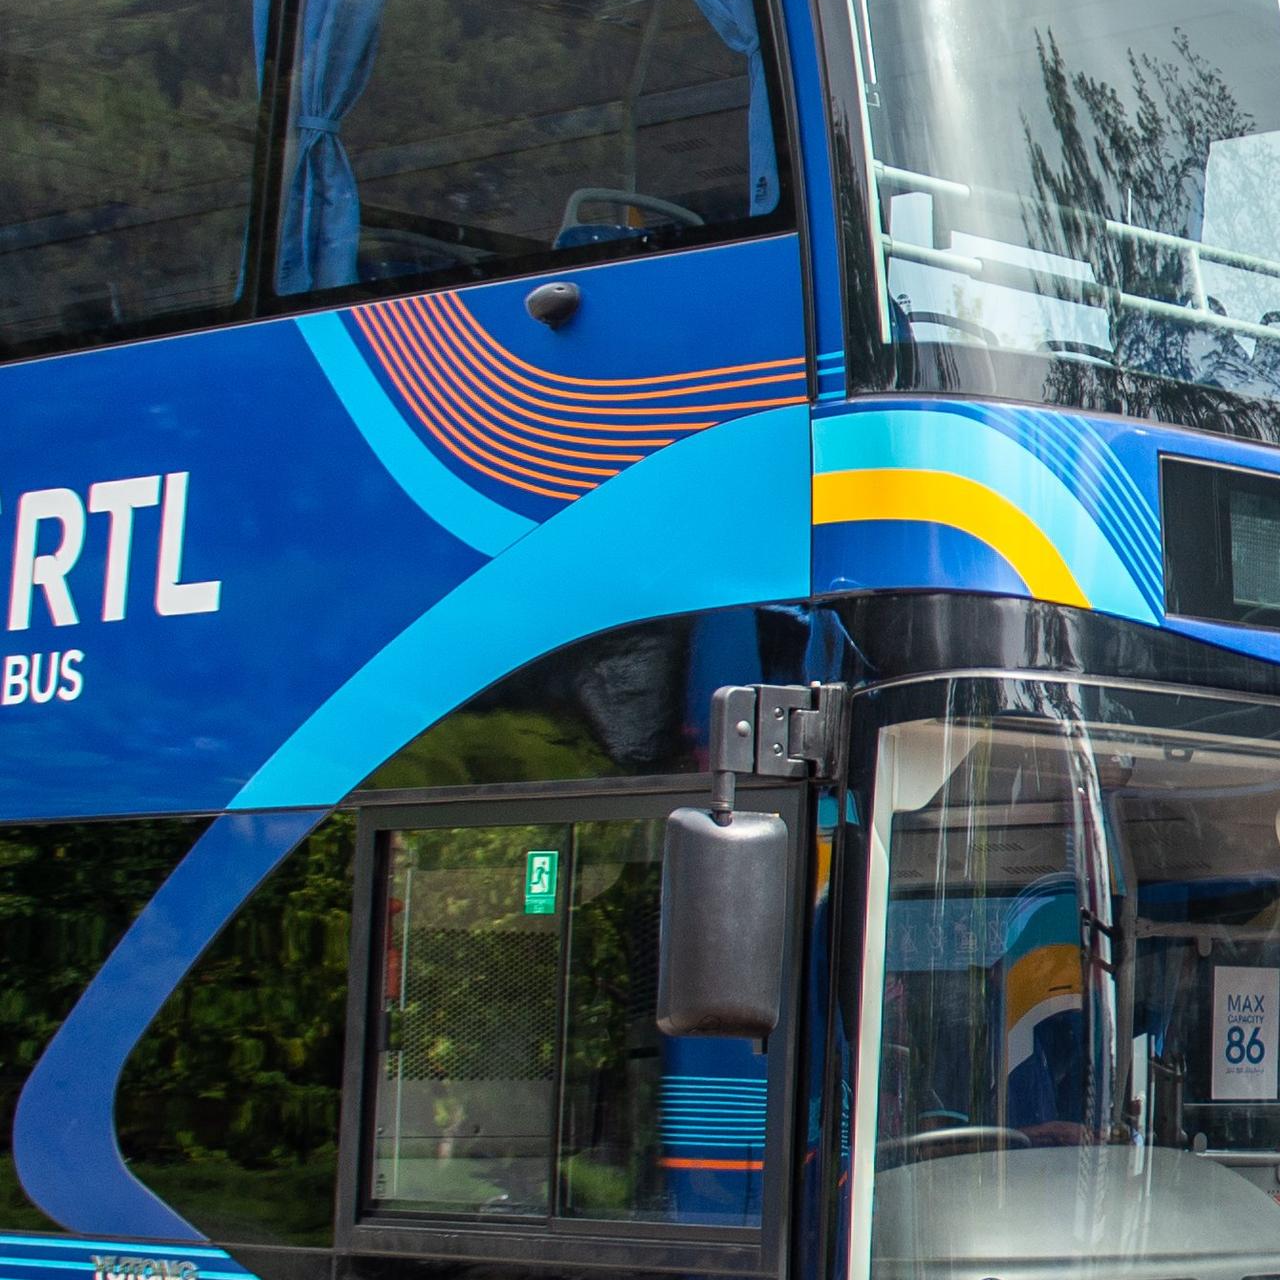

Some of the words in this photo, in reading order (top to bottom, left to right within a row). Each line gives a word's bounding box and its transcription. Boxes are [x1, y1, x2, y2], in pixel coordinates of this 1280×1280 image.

[8, 471, 222, 632] RTL
[1, 649, 86, 706] BUS
[1226, 994, 1265, 1013] MAX
[1226, 1015, 1265, 1025] CAPACITY
[1225, 1025, 1265, 1064] 86
